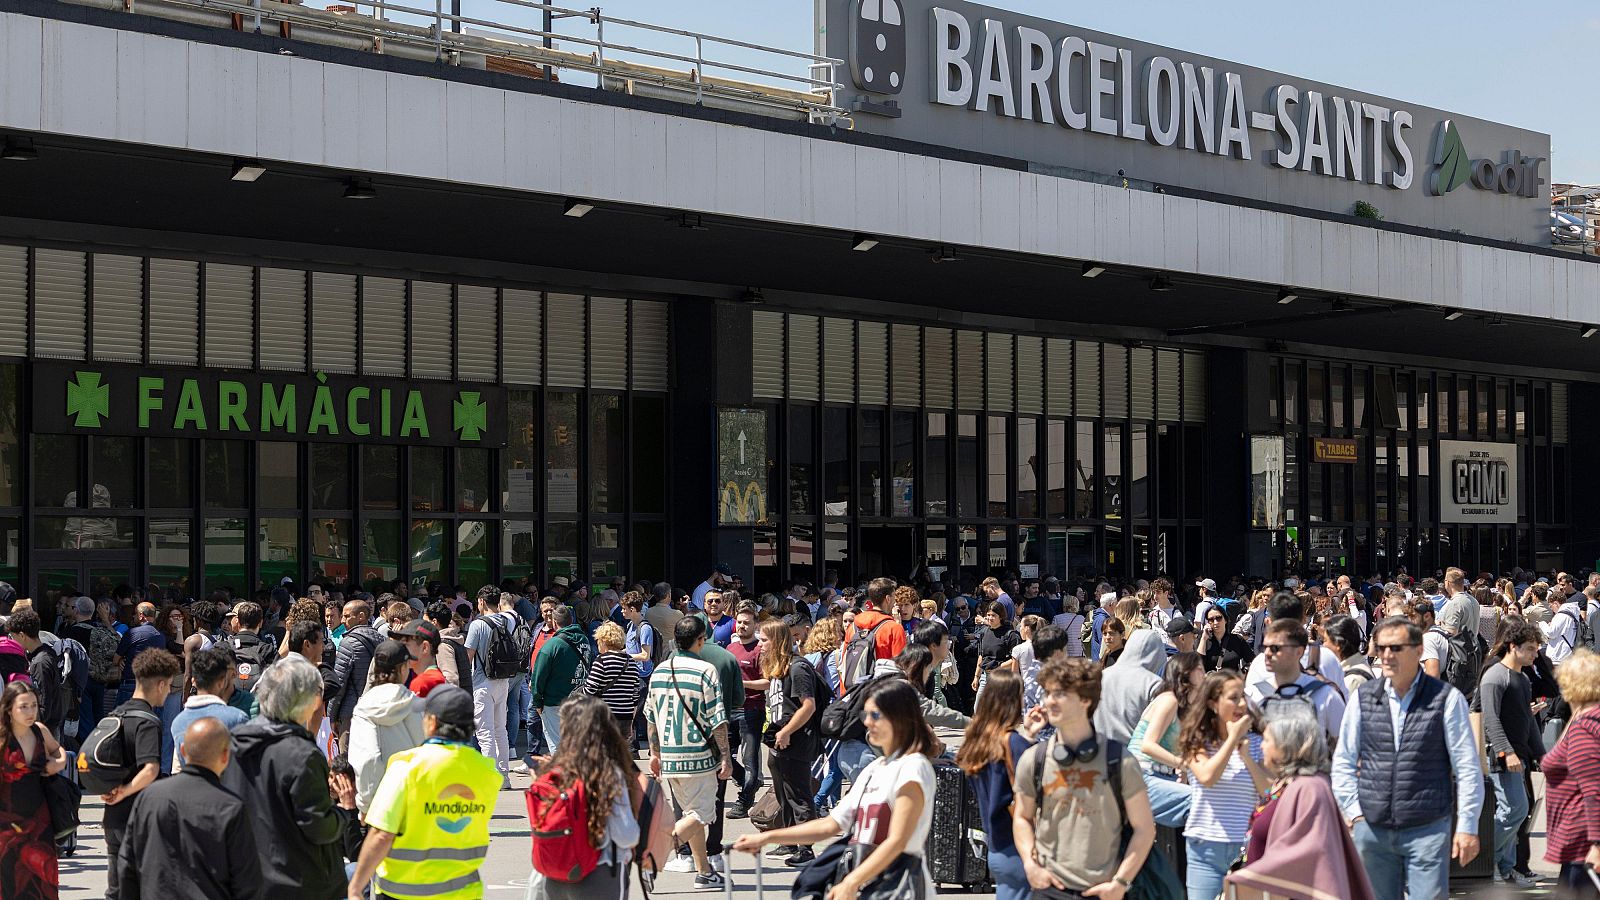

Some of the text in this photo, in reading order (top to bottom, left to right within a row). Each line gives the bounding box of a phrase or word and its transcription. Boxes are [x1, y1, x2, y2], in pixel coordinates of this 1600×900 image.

[929, 5, 1413, 190] BARCELONA-SANTS
[1470, 149, 1546, 198] adif
[138, 370, 430, 438] FARMÀCIA
[1326, 444, 1356, 455] TABACS
[1453, 460, 1509, 505] COMO
[424, 801, 486, 816] Mundiplan
